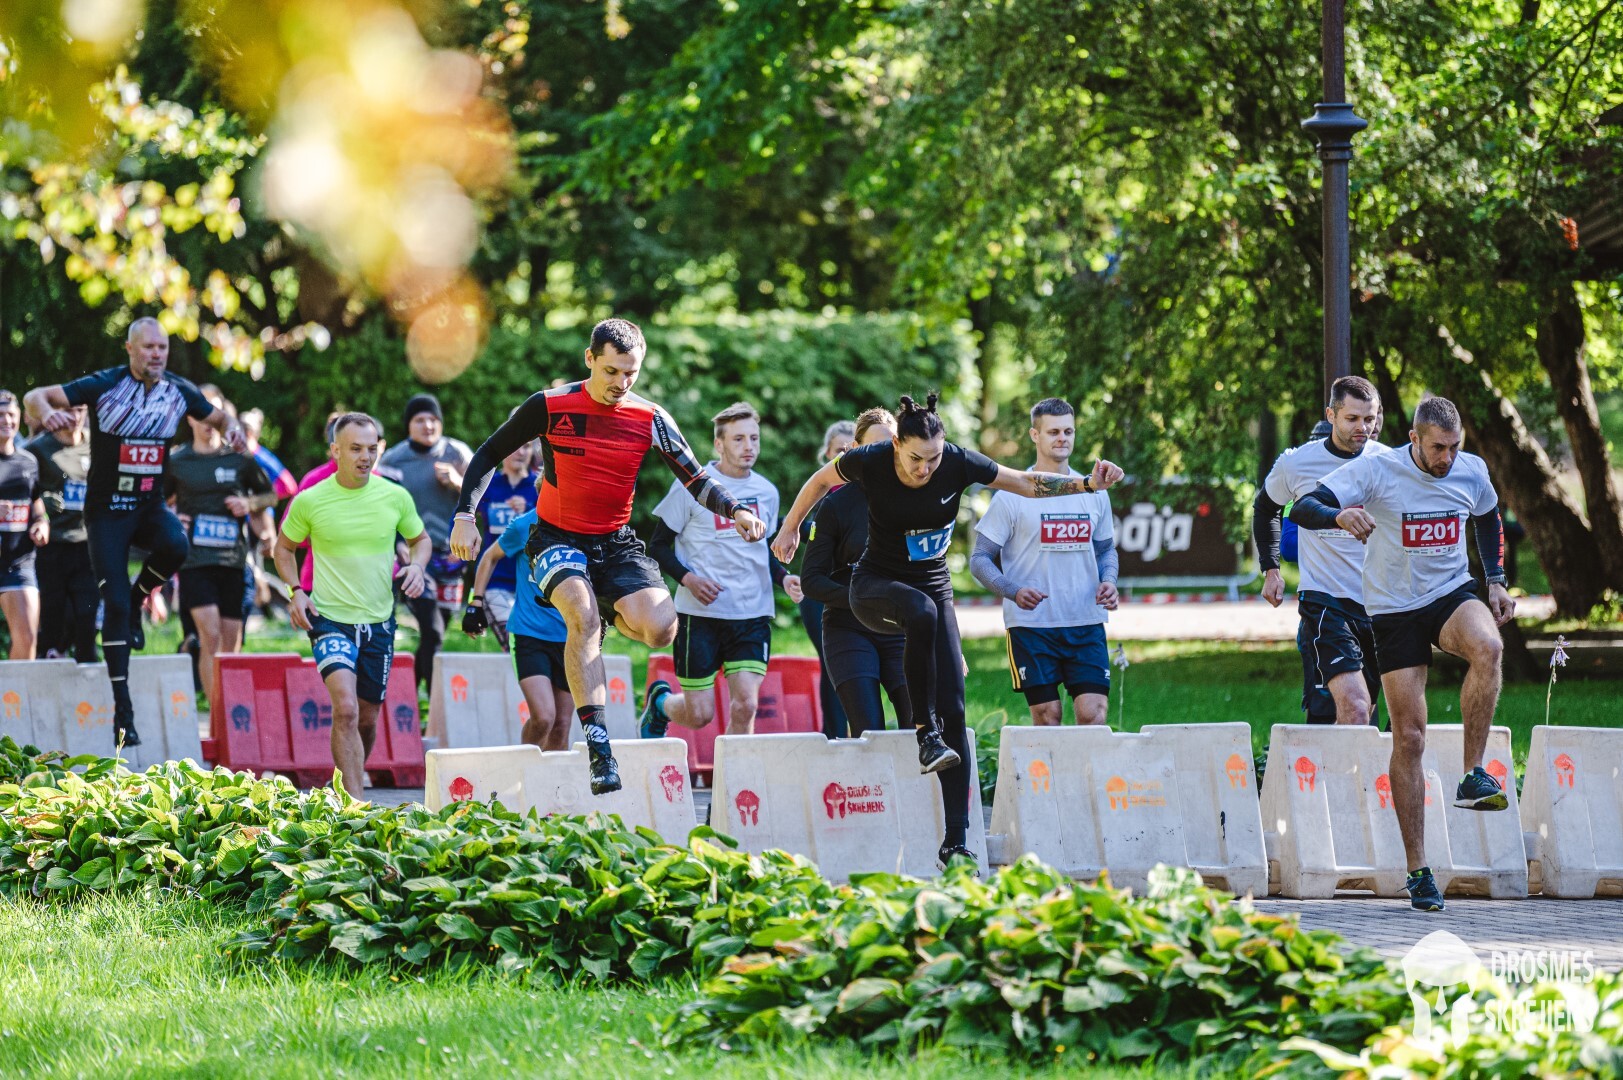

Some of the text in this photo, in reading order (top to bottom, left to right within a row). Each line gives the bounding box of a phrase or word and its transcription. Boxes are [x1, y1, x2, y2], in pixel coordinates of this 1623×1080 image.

[128, 446, 159, 463] 173
[1043, 523, 1089, 538] T202
[1405, 521, 1457, 542] T201
[540, 550, 575, 571] 147
[319, 639, 351, 655] 132
